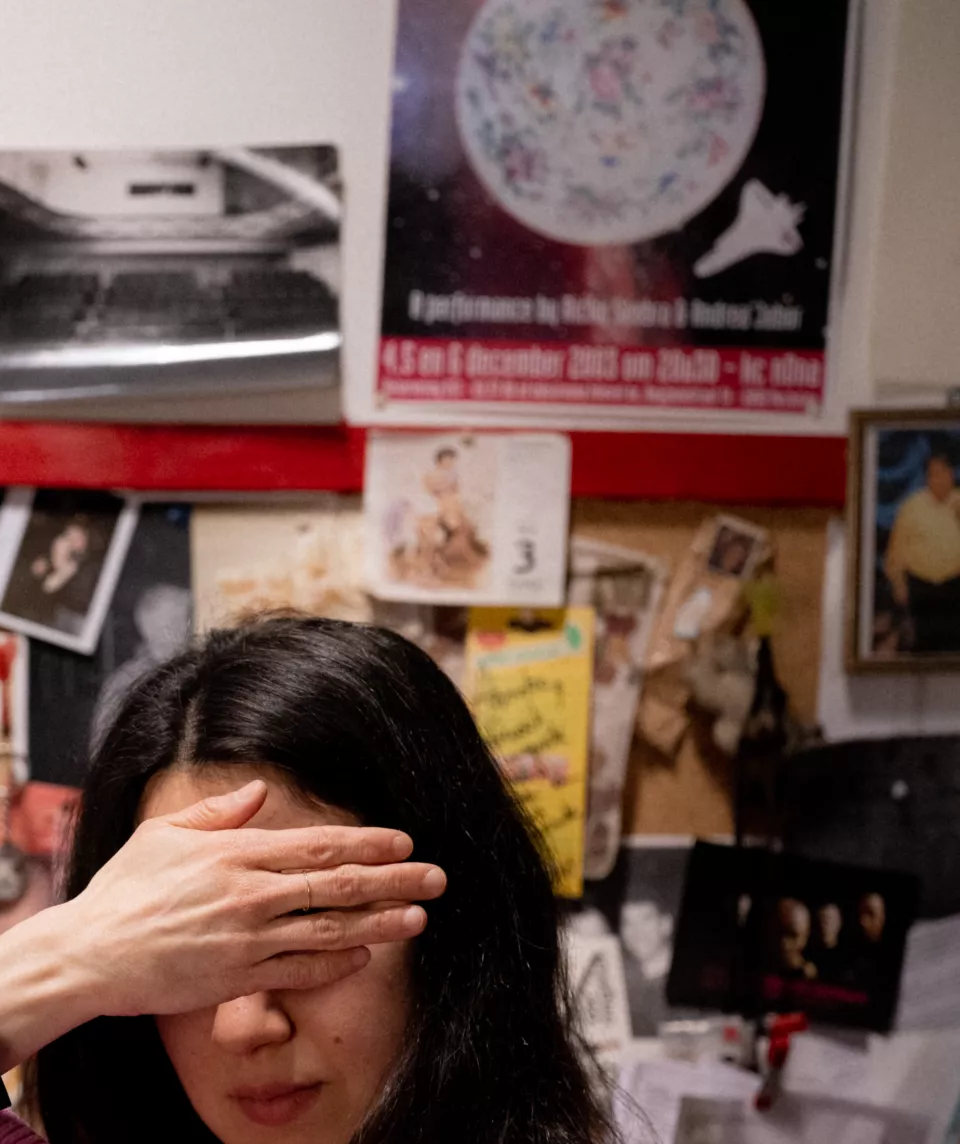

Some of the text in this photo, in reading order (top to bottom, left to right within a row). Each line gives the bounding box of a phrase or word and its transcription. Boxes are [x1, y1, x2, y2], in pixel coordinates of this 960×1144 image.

[424, 290, 533, 327] performance
[536, 292, 560, 329] by
[418, 346, 446, 376] en
[466, 342, 563, 379] december
[621, 351, 655, 383] om
[512, 537, 537, 575] 3
